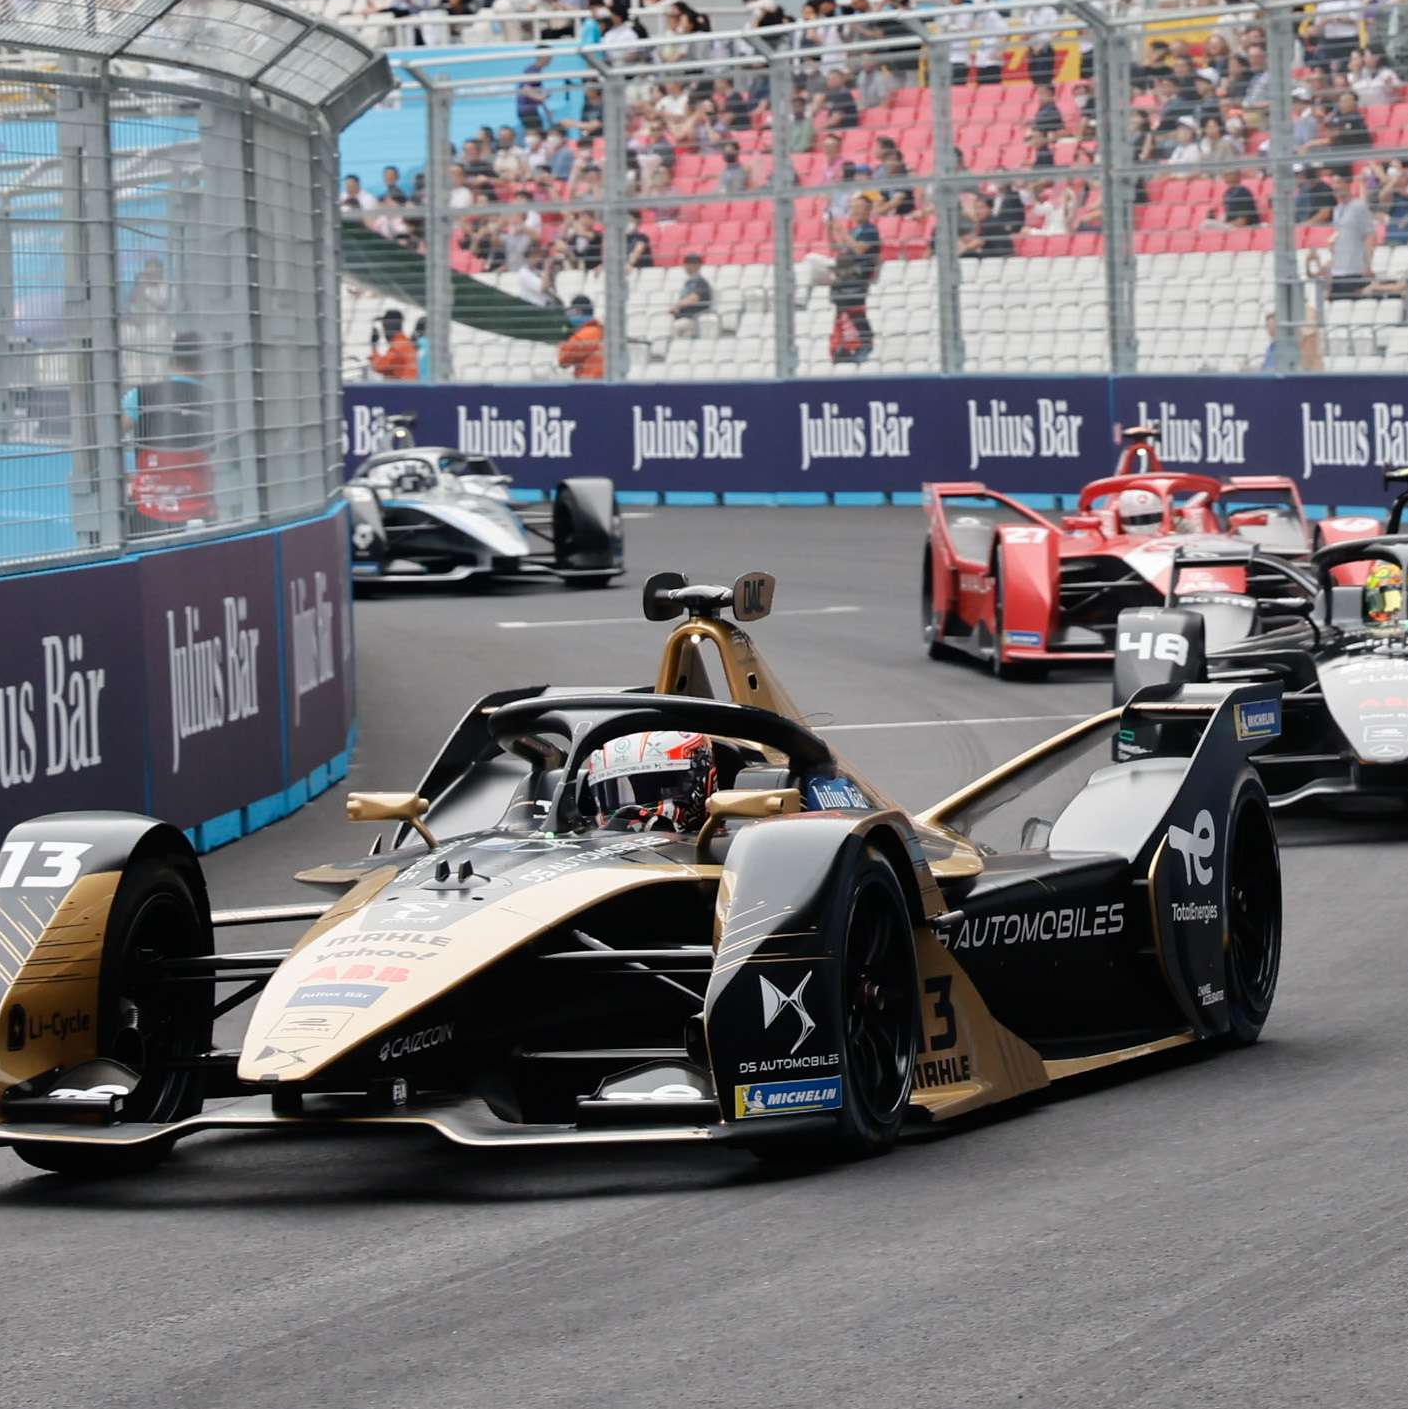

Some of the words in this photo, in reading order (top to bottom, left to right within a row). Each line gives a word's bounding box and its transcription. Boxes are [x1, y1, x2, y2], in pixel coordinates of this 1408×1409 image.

[457, 405, 527, 458] Julius
[530, 405, 576, 458] Bär
[633, 405, 701, 470] Julius
[705, 405, 747, 459] Bär
[799, 401, 866, 471] Julius
[868, 401, 914, 458] Bär
[967, 400, 1035, 470] Julius
[1037, 399, 1083, 458] Bär
[1205, 403, 1249, 464] Bär
[1302, 403, 1370, 479] Julius
[1004, 526, 1050, 544] 27
[744, 579, 765, 614] DAC
[1118, 632, 1189, 666] 48
[167, 605, 224, 774] Julius
[223, 596, 259, 721] Bär
[42, 633, 105, 777] Bär
[1247, 712, 1276, 727] MICHELIN
[811, 784, 851, 810] Julius
[953, 902, 1125, 950] AUTOMOBILES
[1171, 901, 1218, 924] TotalEnergies
[314, 946, 440, 963] yahoo!
[325, 933, 453, 947] MAHLE
[297, 964, 411, 983] ABB
[300, 990, 341, 1000] Julius
[343, 990, 372, 1000] Bär
[29, 1008, 90, 1040] Li-Cycle
[739, 1061, 758, 1074] DS
[759, 1053, 840, 1072] AUTOMOBILES
[767, 1087, 838, 1106] MICHELIN
